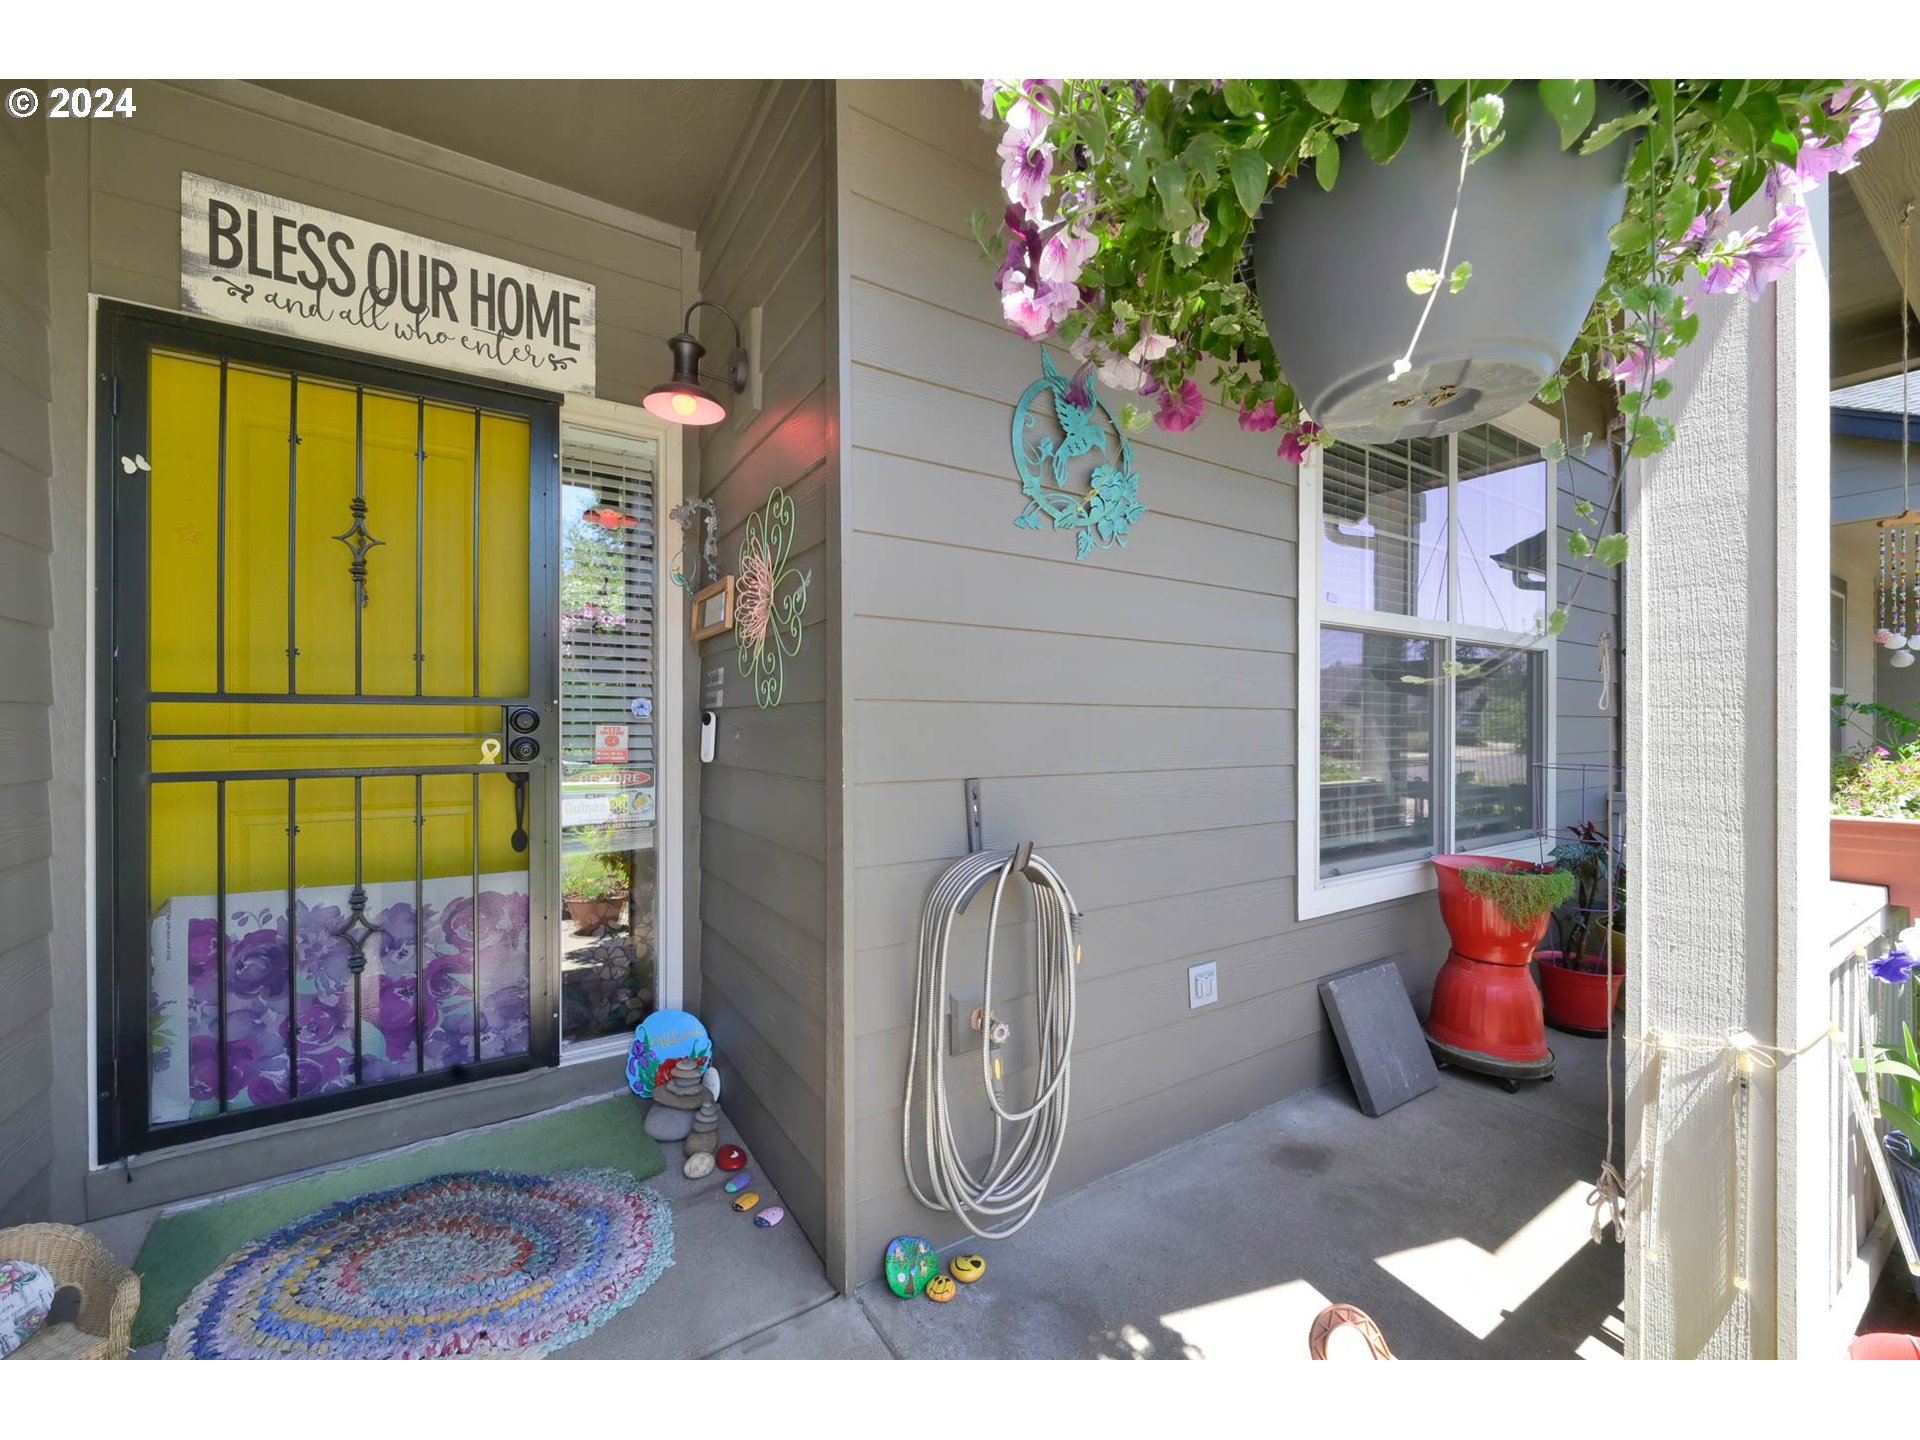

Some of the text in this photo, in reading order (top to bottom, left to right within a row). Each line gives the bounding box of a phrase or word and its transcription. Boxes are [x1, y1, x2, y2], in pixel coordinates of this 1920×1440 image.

[208, 198, 581, 351] BLESS OUR HOME
[264, 285, 547, 368] and all who enter
